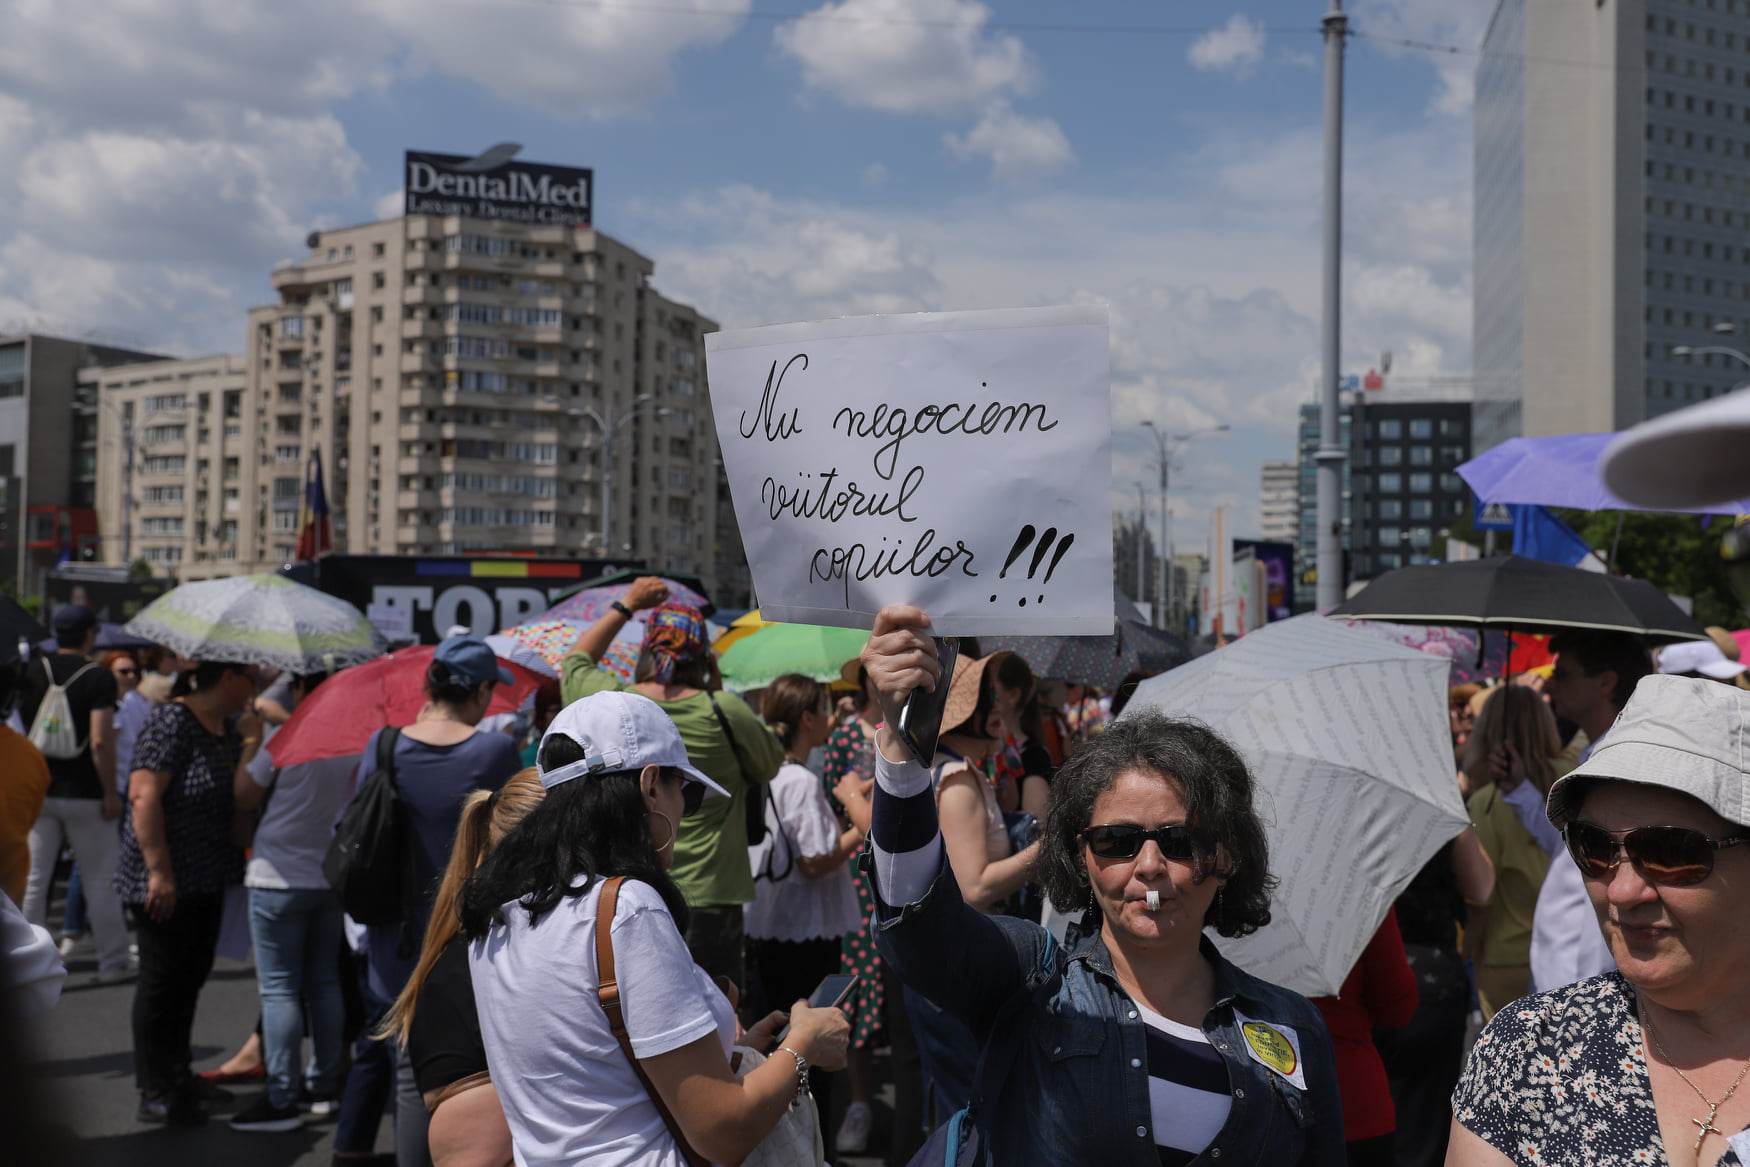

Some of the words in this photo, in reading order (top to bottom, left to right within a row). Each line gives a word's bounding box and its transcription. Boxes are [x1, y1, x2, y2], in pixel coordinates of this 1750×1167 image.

[408, 161, 588, 208] DentalMed
[739, 353, 809, 441] Nu
[832, 381, 1058, 480] negociem
[761, 465, 924, 523] viitorul
[809, 528, 978, 608] copiilor
